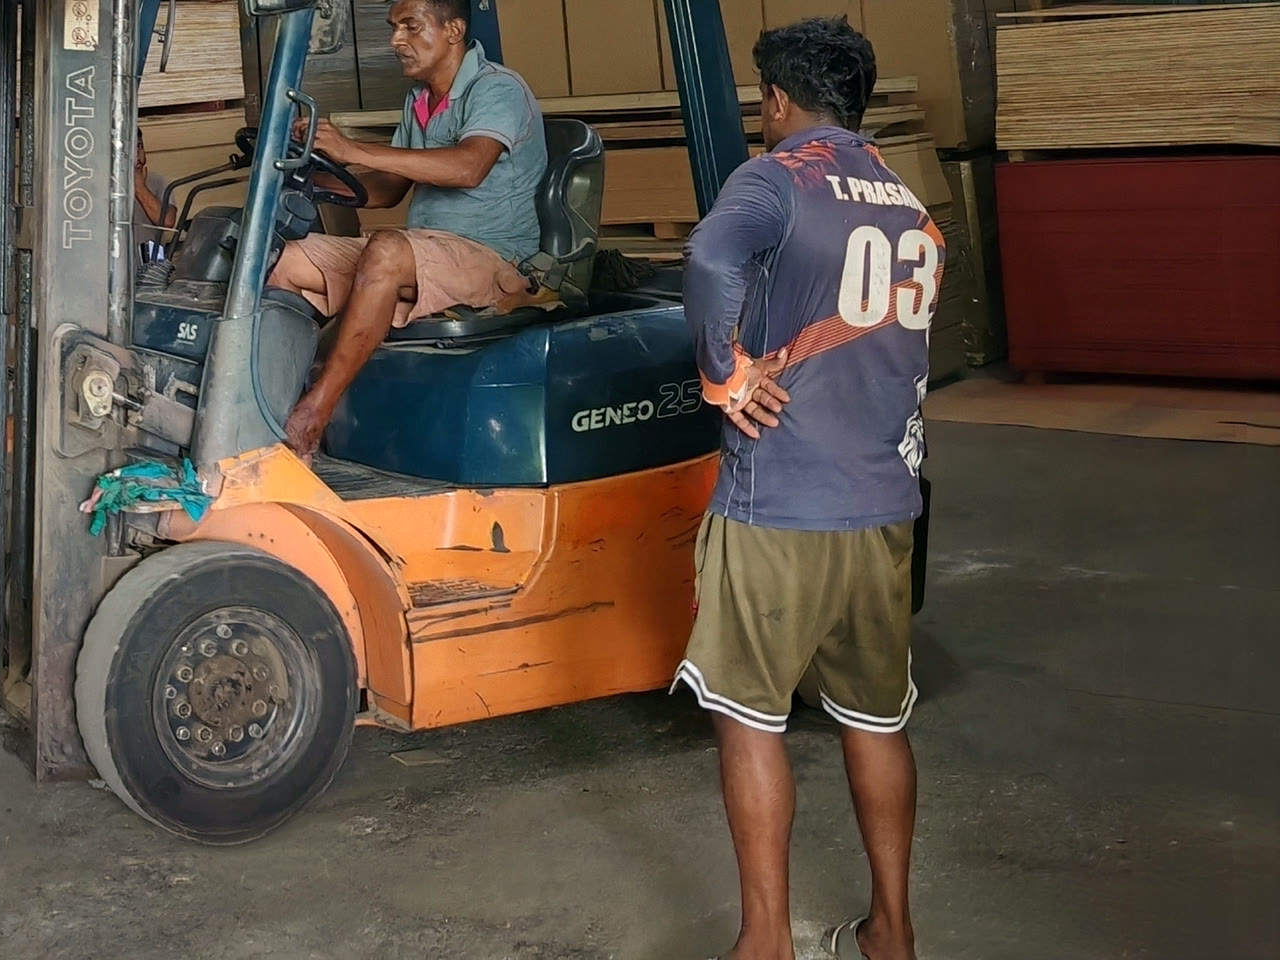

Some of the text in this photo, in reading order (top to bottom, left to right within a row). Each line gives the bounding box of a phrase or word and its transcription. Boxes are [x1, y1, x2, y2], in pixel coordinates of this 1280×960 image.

[63, 65, 95, 249] TOYOTA
[825, 175, 849, 201] T.
[838, 226, 938, 330] 03
[571, 378, 702, 432] GENEO 25
